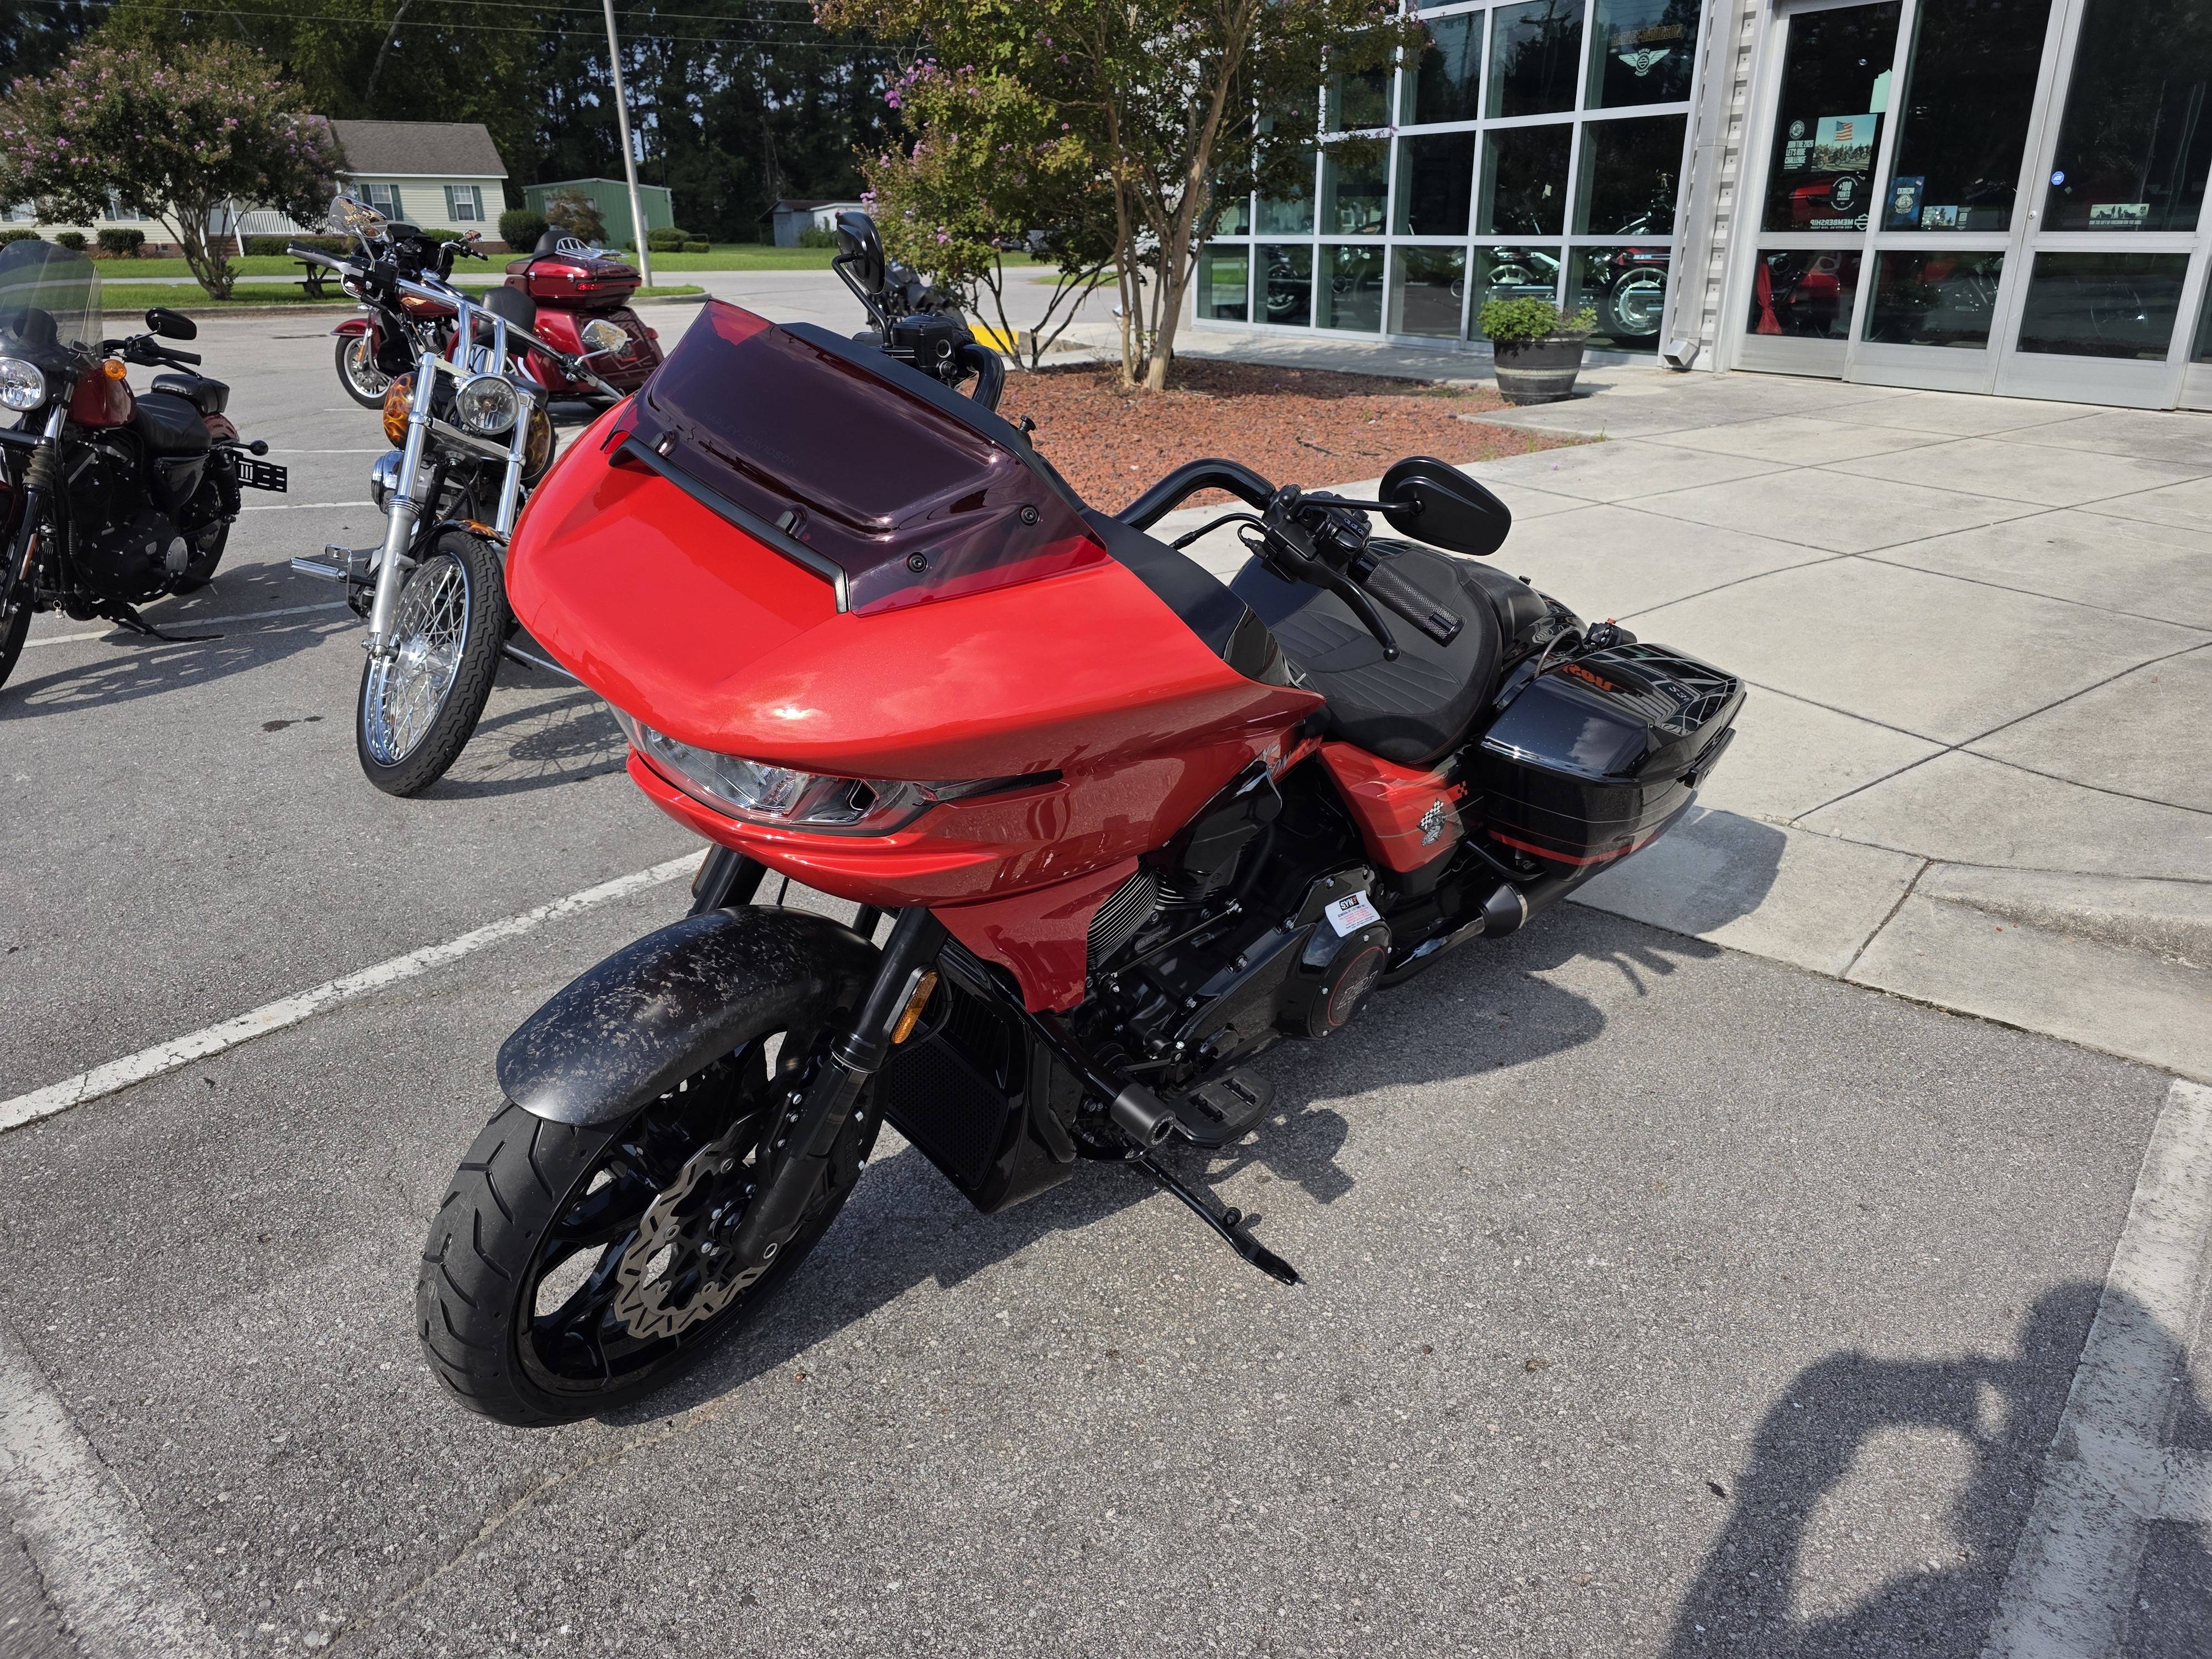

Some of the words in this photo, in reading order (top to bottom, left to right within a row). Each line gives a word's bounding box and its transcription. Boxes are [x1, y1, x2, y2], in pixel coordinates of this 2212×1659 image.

[1611, 24, 1682, 46] HARLEY-DAVIDSON
[704, 413, 799, 468] HARLEY-DAVIDSON
[1340, 896, 1357, 909] SYN3
[1339, 970, 1378, 1005] 121
